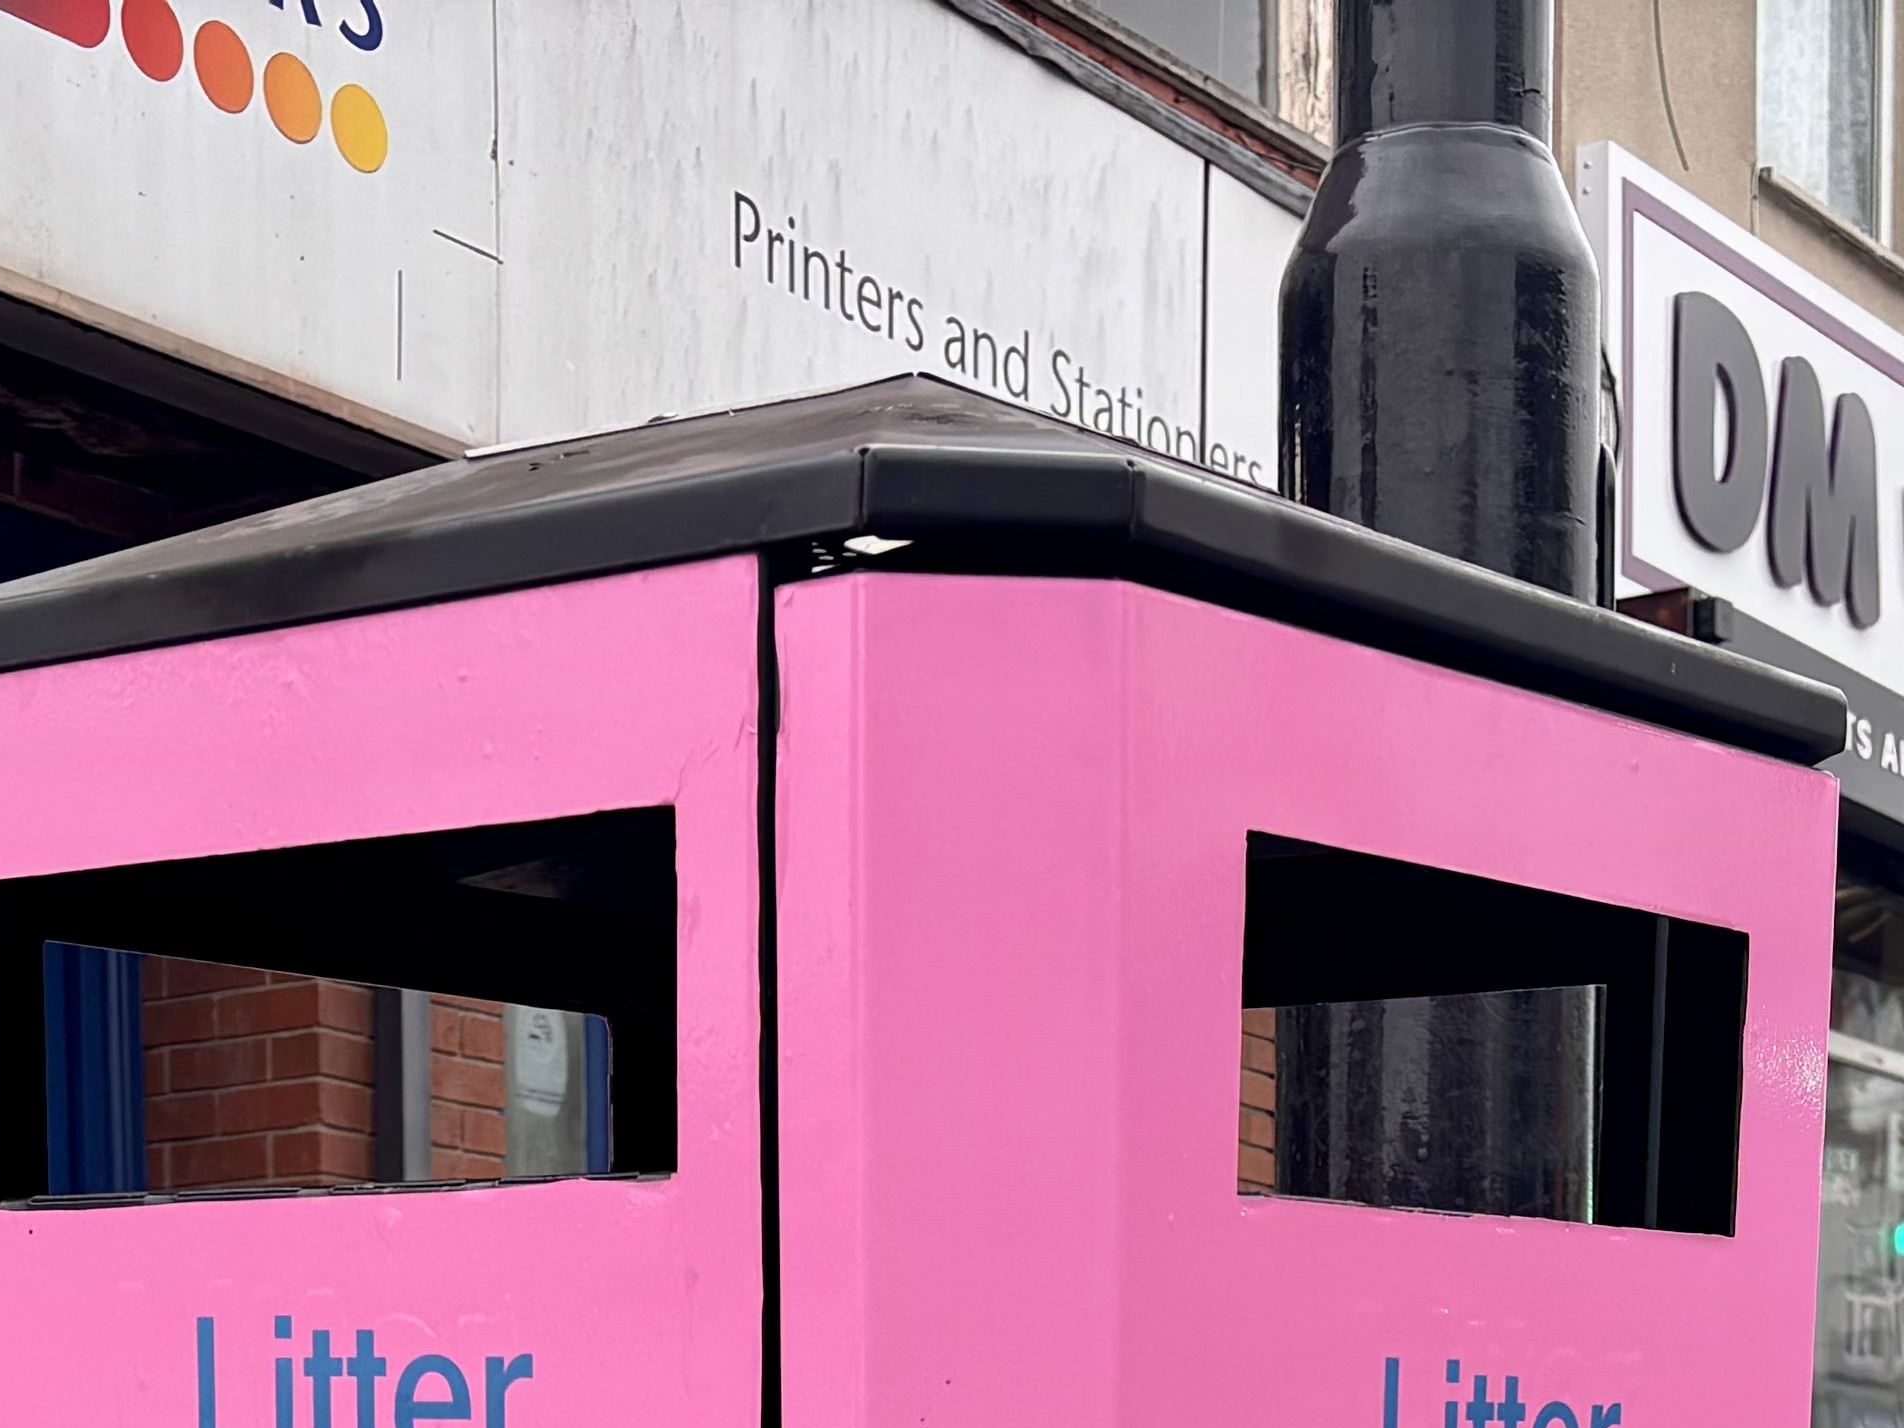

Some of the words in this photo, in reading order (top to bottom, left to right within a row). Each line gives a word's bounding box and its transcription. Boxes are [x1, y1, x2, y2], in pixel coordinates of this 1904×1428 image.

[733, 190, 925, 352] Printers
[943, 329, 1030, 402] and
[1670, 290, 1881, 630] DM
